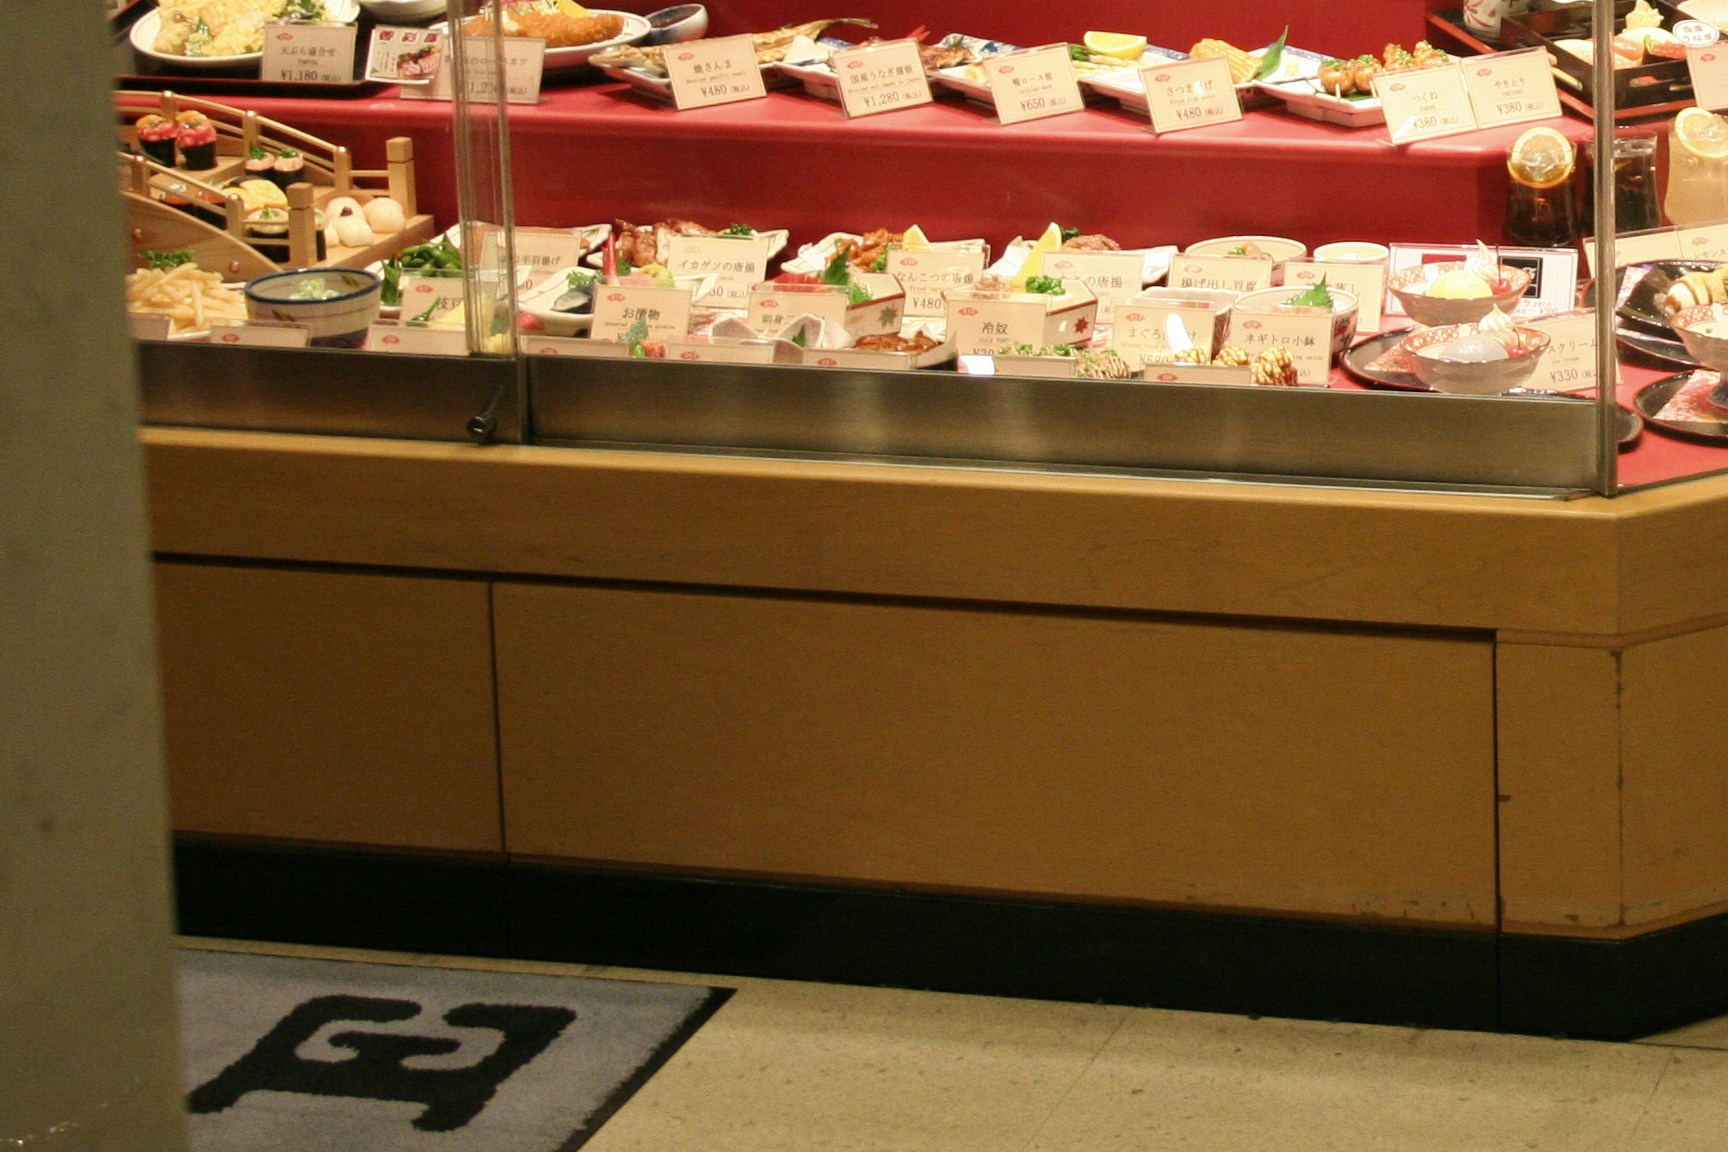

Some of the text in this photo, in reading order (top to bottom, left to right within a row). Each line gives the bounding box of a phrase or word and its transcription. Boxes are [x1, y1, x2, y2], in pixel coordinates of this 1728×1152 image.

[693, 60, 733, 74] 焼さんま
[280, 68, 319, 82] ¥1,180
[1166, 78, 1213, 97] さつまげ
[1494, 77, 1526, 89] やきとり
[700, 84, 728, 99] ¥480
[1410, 91, 1440, 103] つくね
[863, 91, 900, 108] ¥1,280
[1019, 97, 1046, 112] ¥650
[1175, 105, 1202, 121] ¥480
[1495, 101, 1523, 116] ¥380
[678, 259, 756, 273] イカゲソの唐揚
[896, 271, 975, 284] なんこつの唐揚
[912, 297, 942, 310] ¥480
[981, 321, 1008, 336] 冷奴
[1247, 332, 1317, 347] ネギトロ小鉢
[1549, 368, 1578, 383] ¥330
